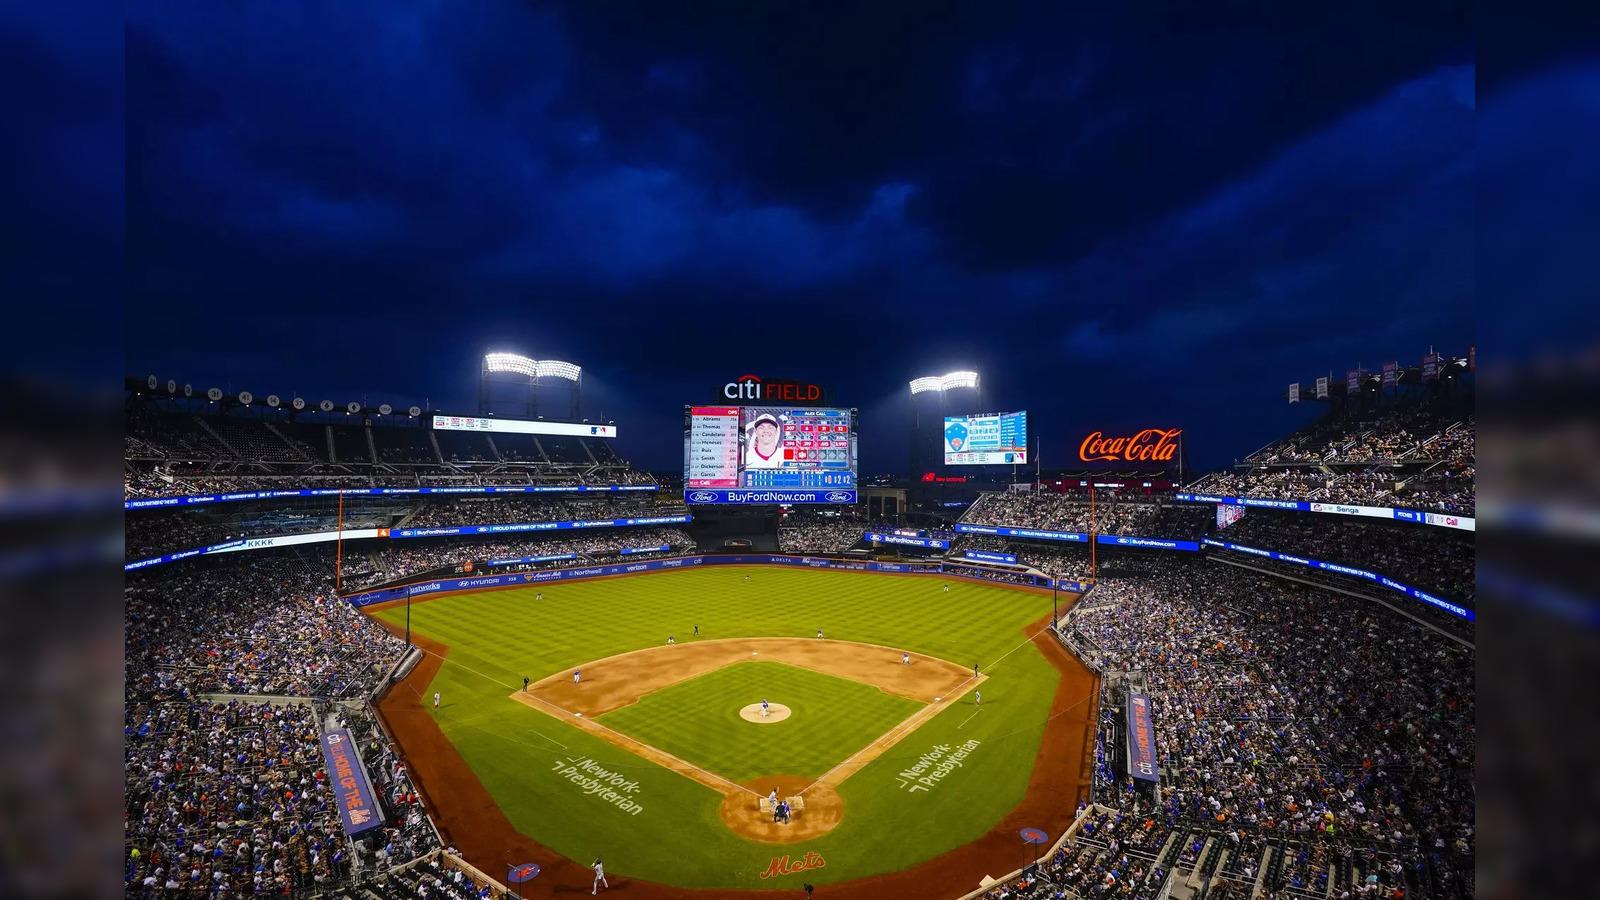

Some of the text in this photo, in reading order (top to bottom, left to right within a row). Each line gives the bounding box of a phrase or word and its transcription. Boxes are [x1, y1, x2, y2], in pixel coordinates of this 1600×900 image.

[724, 379, 820, 400] citi FIELD
[1079, 428, 1183, 462] Coca-Cola
[695, 491, 847, 503] Ford BuyFordNow.com Ford
[1336, 505, 1359, 514] Senga
[1446, 517, 1458, 526] Call
[417, 527, 460, 536] BuyFordNow.com
[885, 536, 925, 545] BuyFordNow.com
[1132, 539, 1176, 547] BuyFordNow.com
[574, 568, 603, 576] Northwell
[626, 564, 647, 572] verizon
[470, 578, 500, 586] HYUNDAI
[335, 755, 353, 778] HOME
[918, 739, 981, 787] Presbyterian
[340, 776, 357, 789] OF
[558, 766, 643, 816] Presbyterian
[344, 787, 364, 810] THE
[760, 851, 826, 879] Mets
